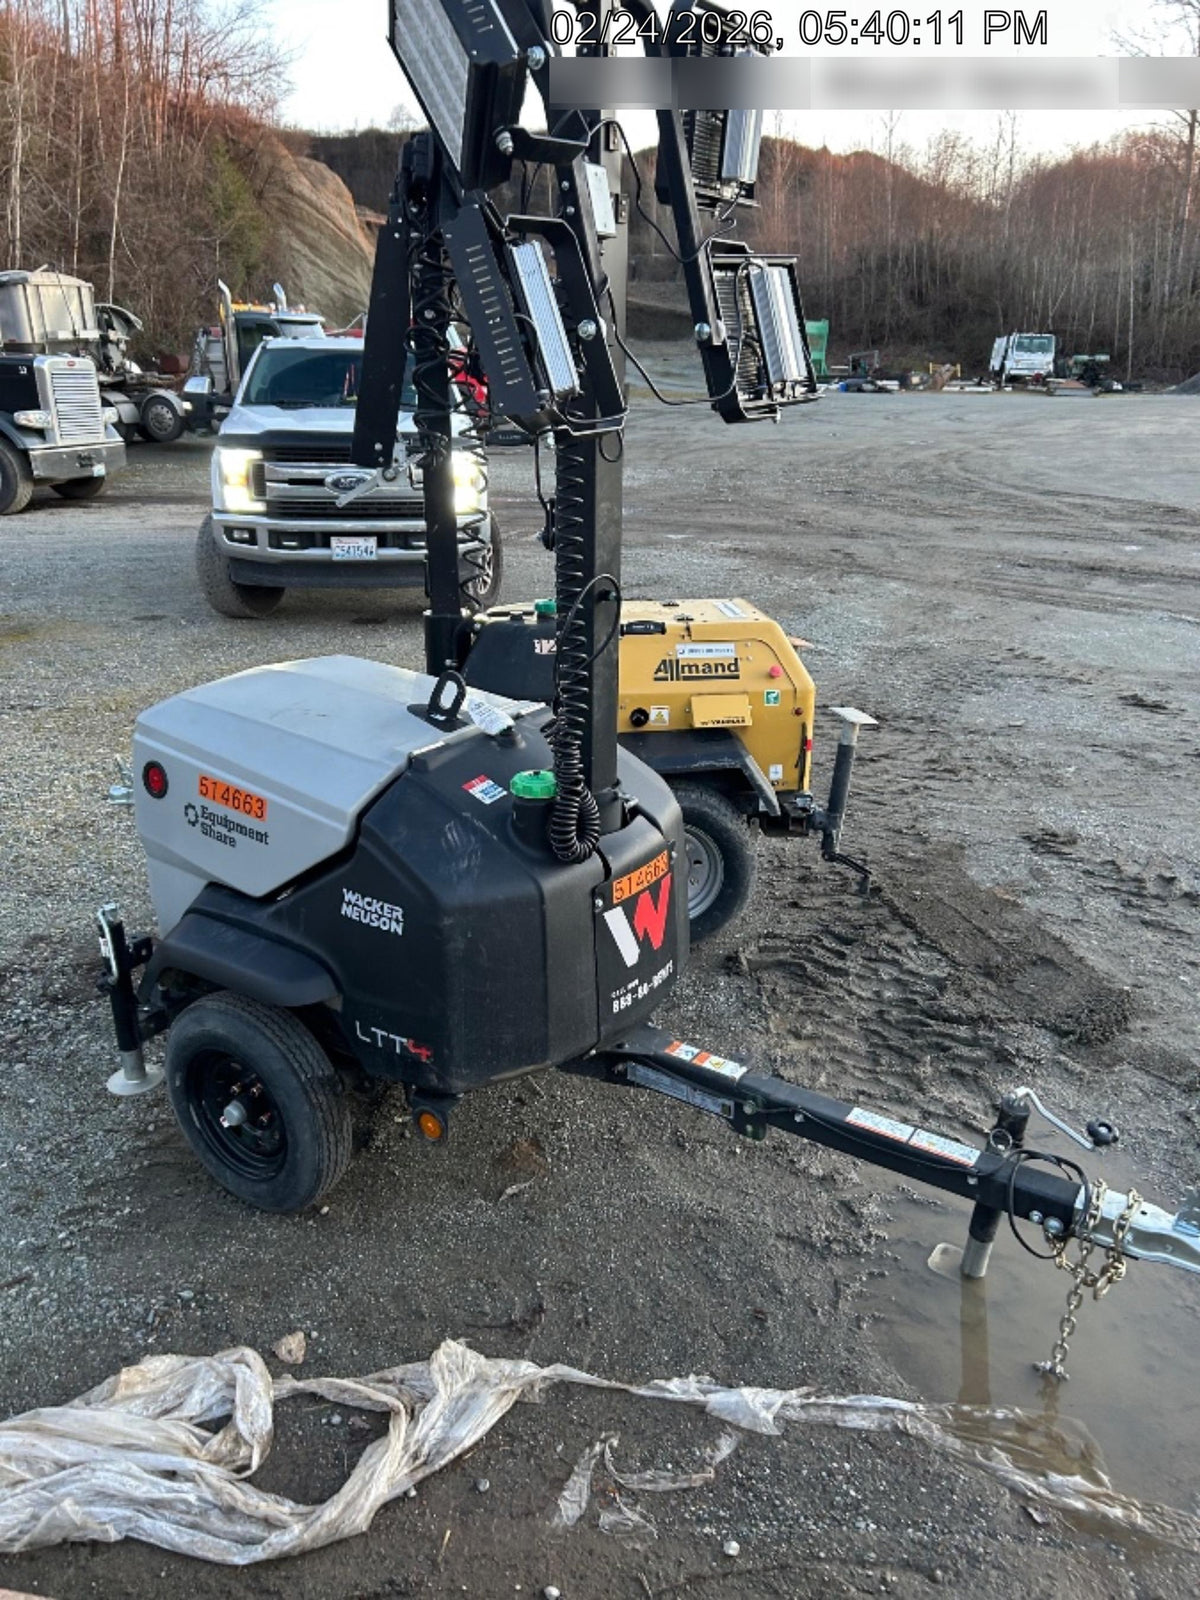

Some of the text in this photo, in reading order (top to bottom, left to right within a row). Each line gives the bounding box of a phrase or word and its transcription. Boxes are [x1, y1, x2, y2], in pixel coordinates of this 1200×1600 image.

[654, 657, 740, 681] Allmand
[199, 776, 265, 819] 514663
[200, 805, 269, 845] Equipment
[200, 822, 237, 848] Share
[614, 852, 669, 900] 514663
[341, 904, 404, 936] NEUSON
[342, 888, 404, 921] WACKER
